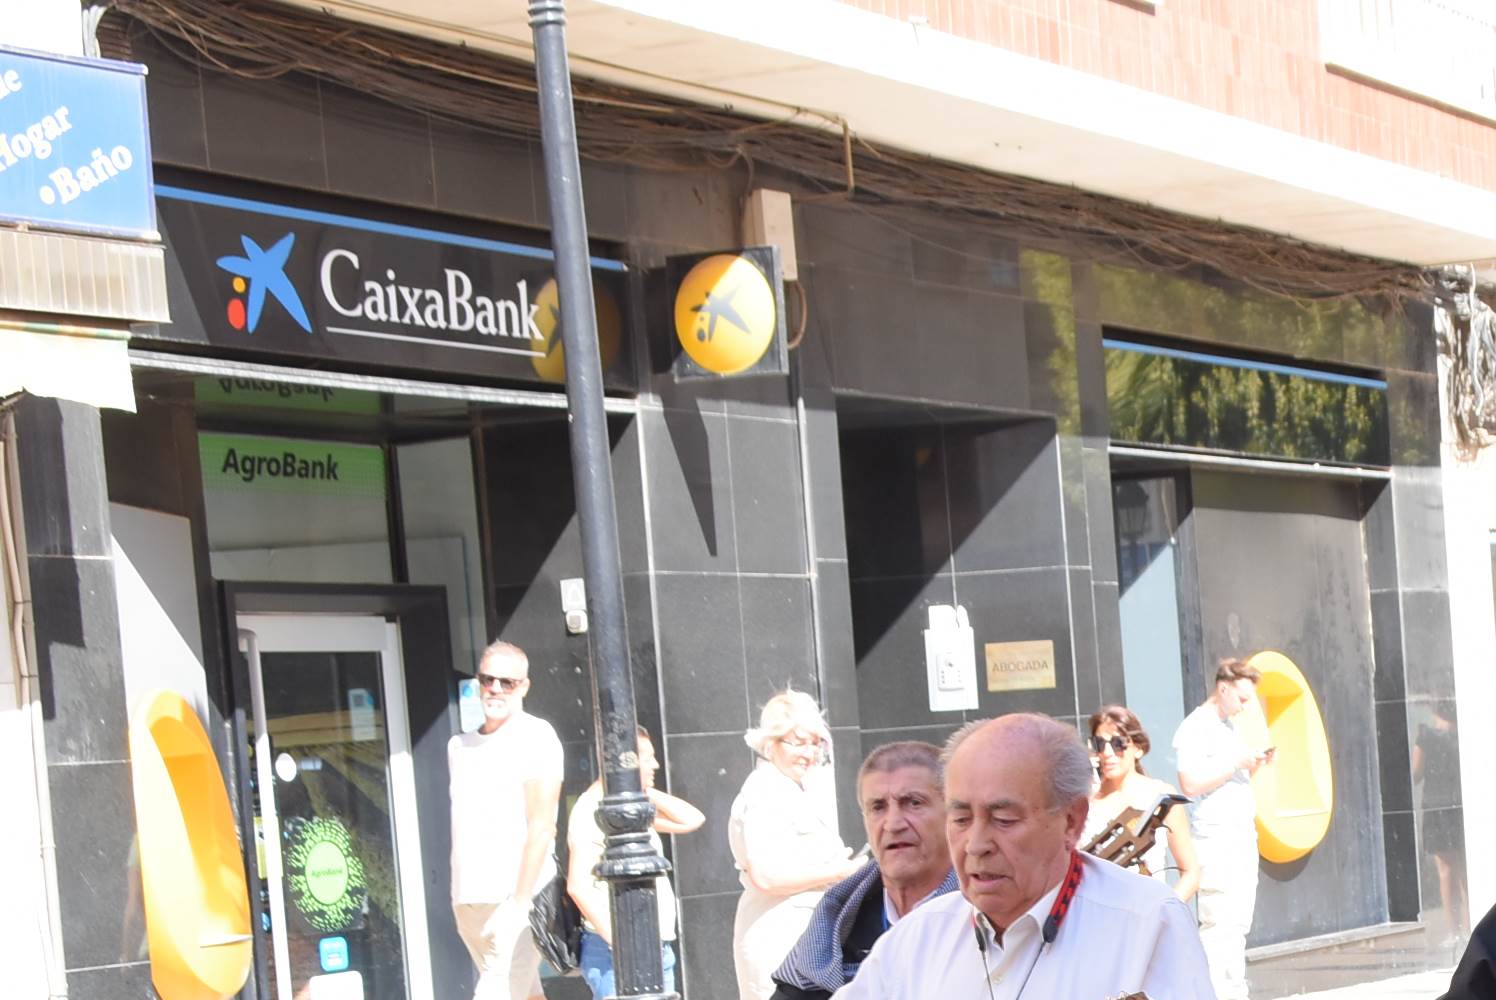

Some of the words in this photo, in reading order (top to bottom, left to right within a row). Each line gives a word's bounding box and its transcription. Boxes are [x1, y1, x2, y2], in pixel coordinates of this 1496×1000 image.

[49, 145, 133, 205] Baño
[320, 248, 545, 341] CaixaBank
[222, 448, 340, 483] AgroBank
[992, 660, 1049, 673] ABOGADA
